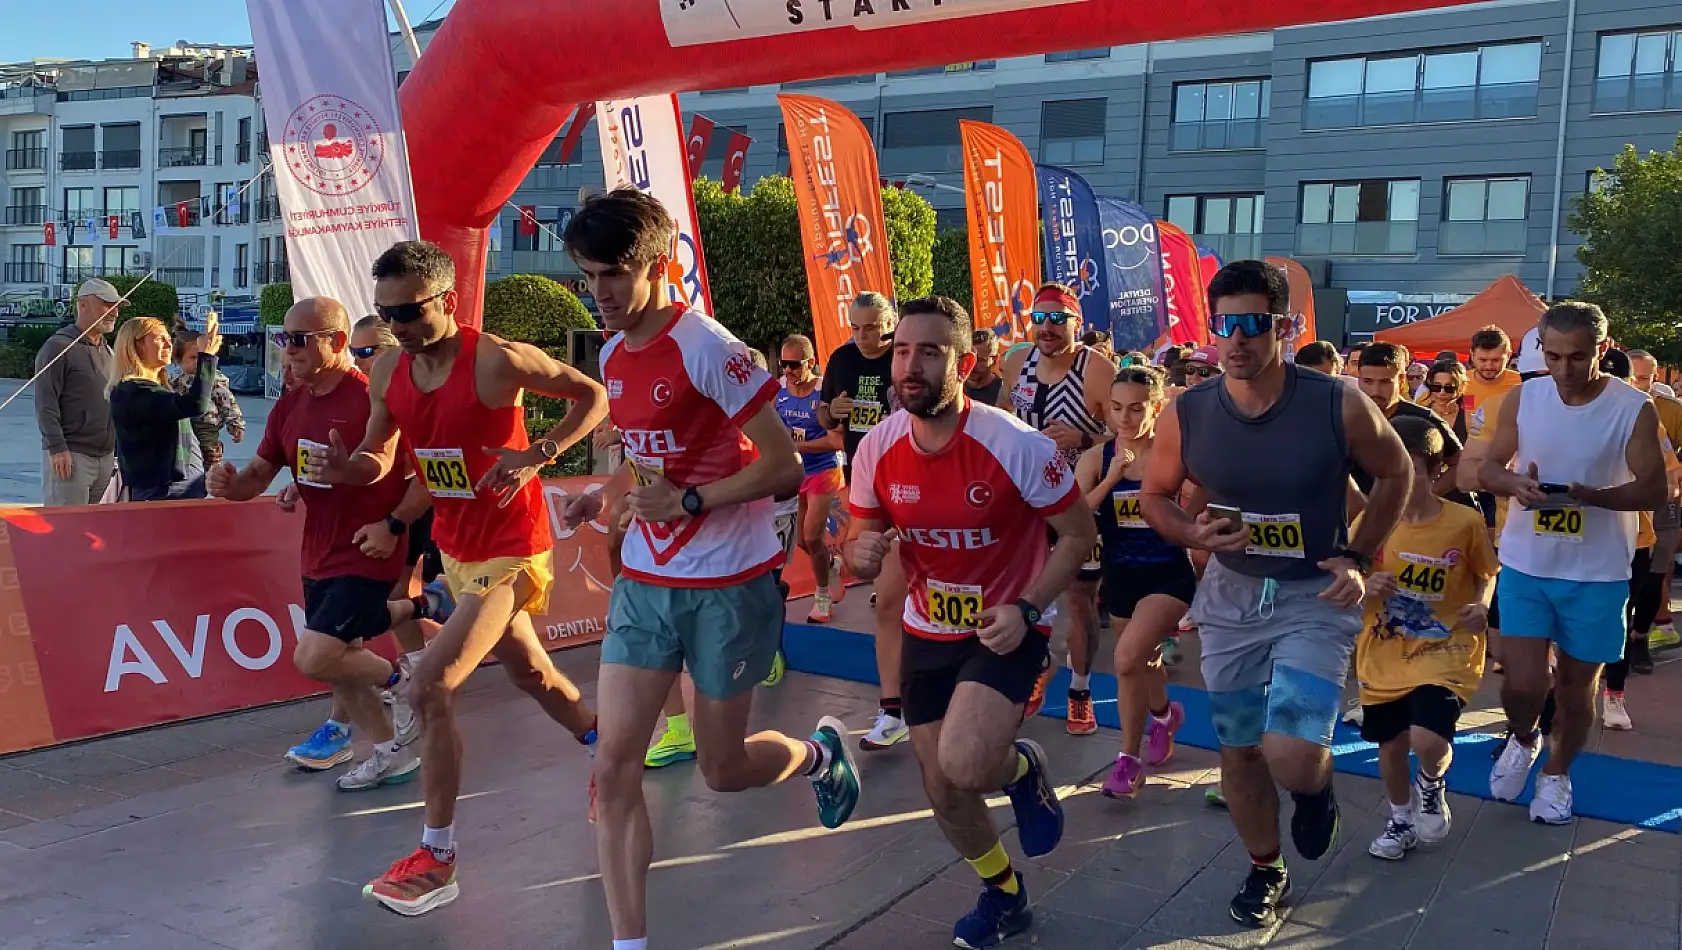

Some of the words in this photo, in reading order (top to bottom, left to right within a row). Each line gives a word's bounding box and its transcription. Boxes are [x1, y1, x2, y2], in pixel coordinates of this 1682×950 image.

[788, 0, 943, 25] STA
[1376, 305, 1420, 324] FOR
[858, 376, 883, 386] RISE.
[785, 410, 810, 419] ITALIA
[852, 407, 877, 426] 352
[427, 460, 467, 489] 403
[1119, 501, 1143, 519] 44
[1538, 509, 1582, 533] 420
[897, 527, 999, 550] VESTEL
[1249, 524, 1299, 548] 360
[1399, 564, 1446, 592] 446
[933, 592, 978, 626] 303
[546, 617, 603, 640] DENTAL
